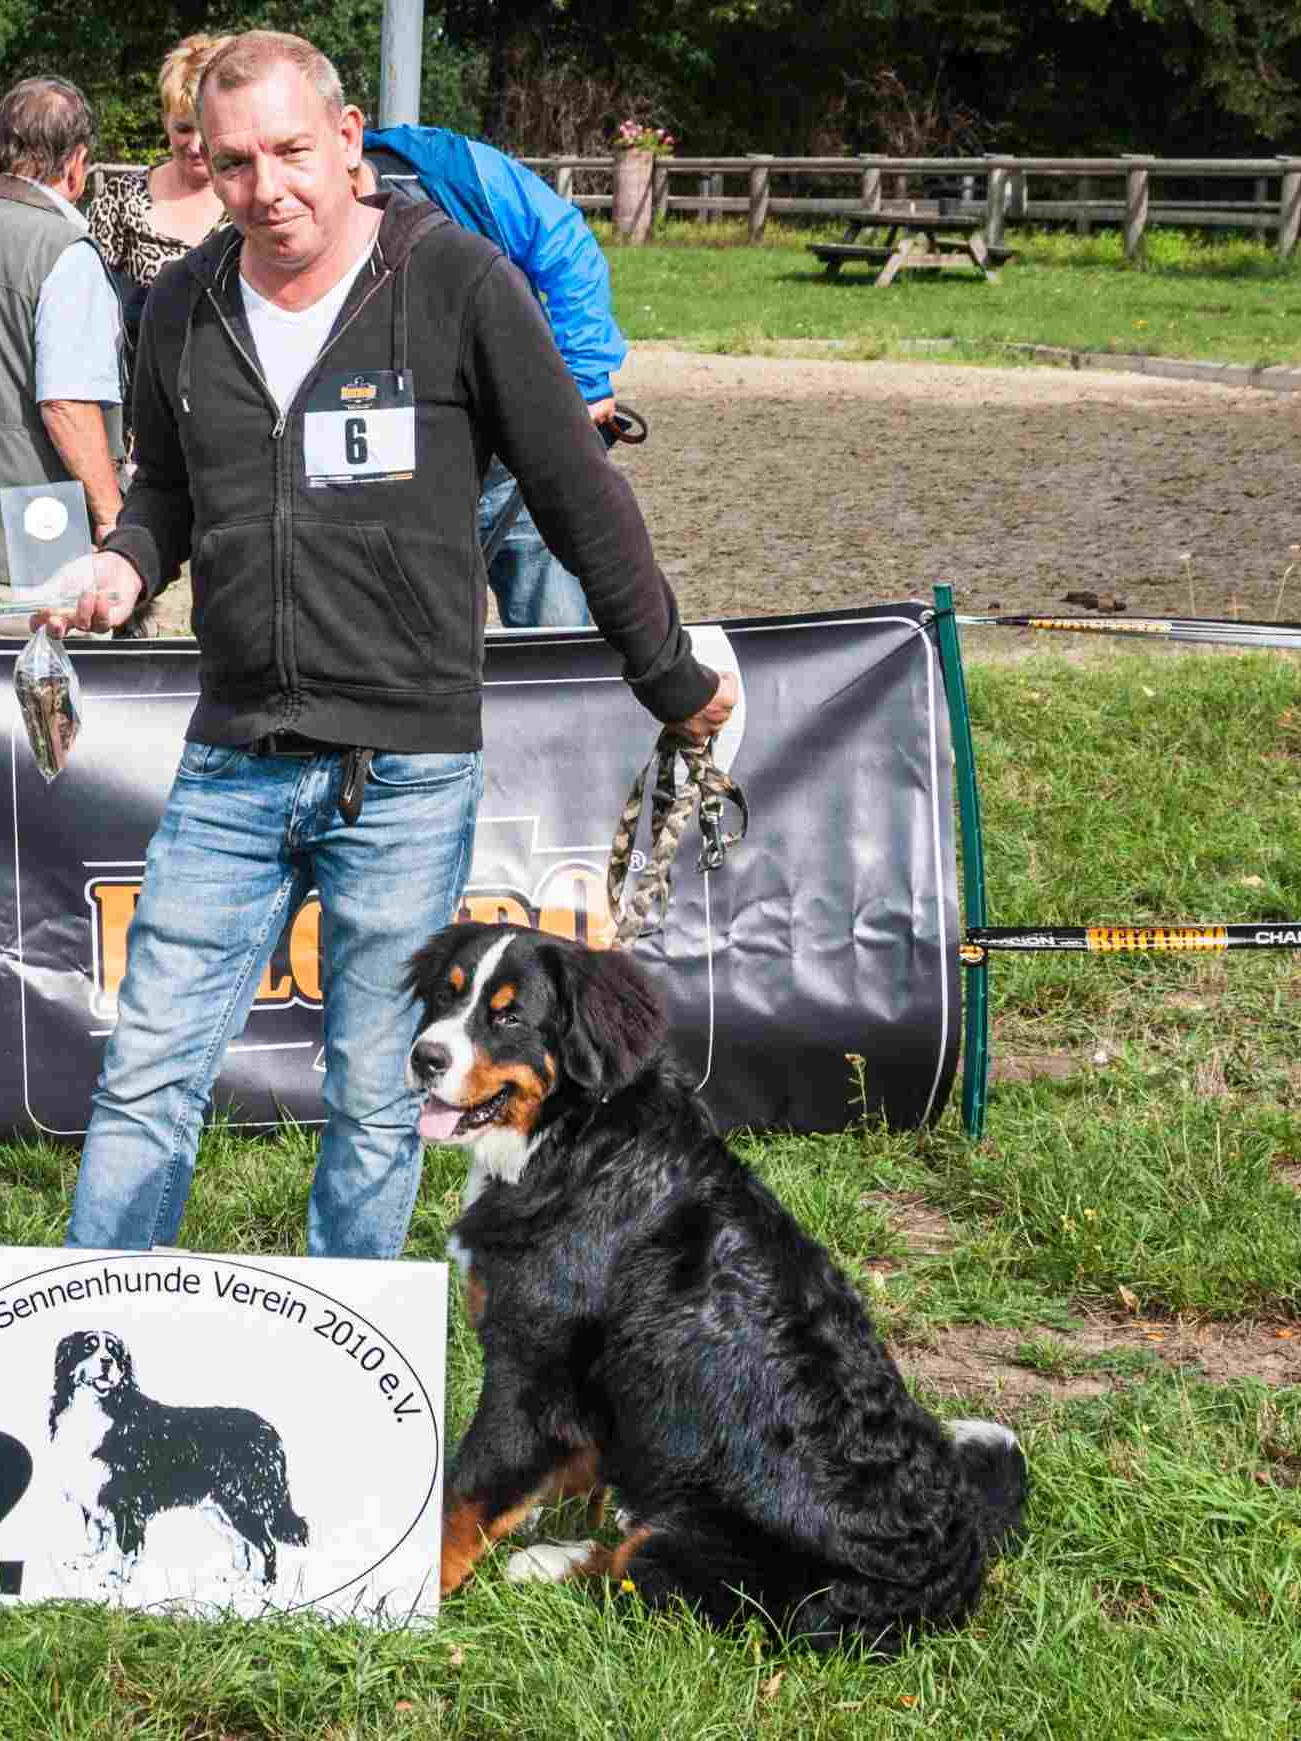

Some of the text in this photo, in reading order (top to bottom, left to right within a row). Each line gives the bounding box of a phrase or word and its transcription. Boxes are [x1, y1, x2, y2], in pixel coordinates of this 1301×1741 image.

[345, 418, 368, 465] 6
[214, 1271, 307, 1324] Verein
[313, 1309, 386, 1372] 2010
[378, 1372, 422, 1423] e.V.
